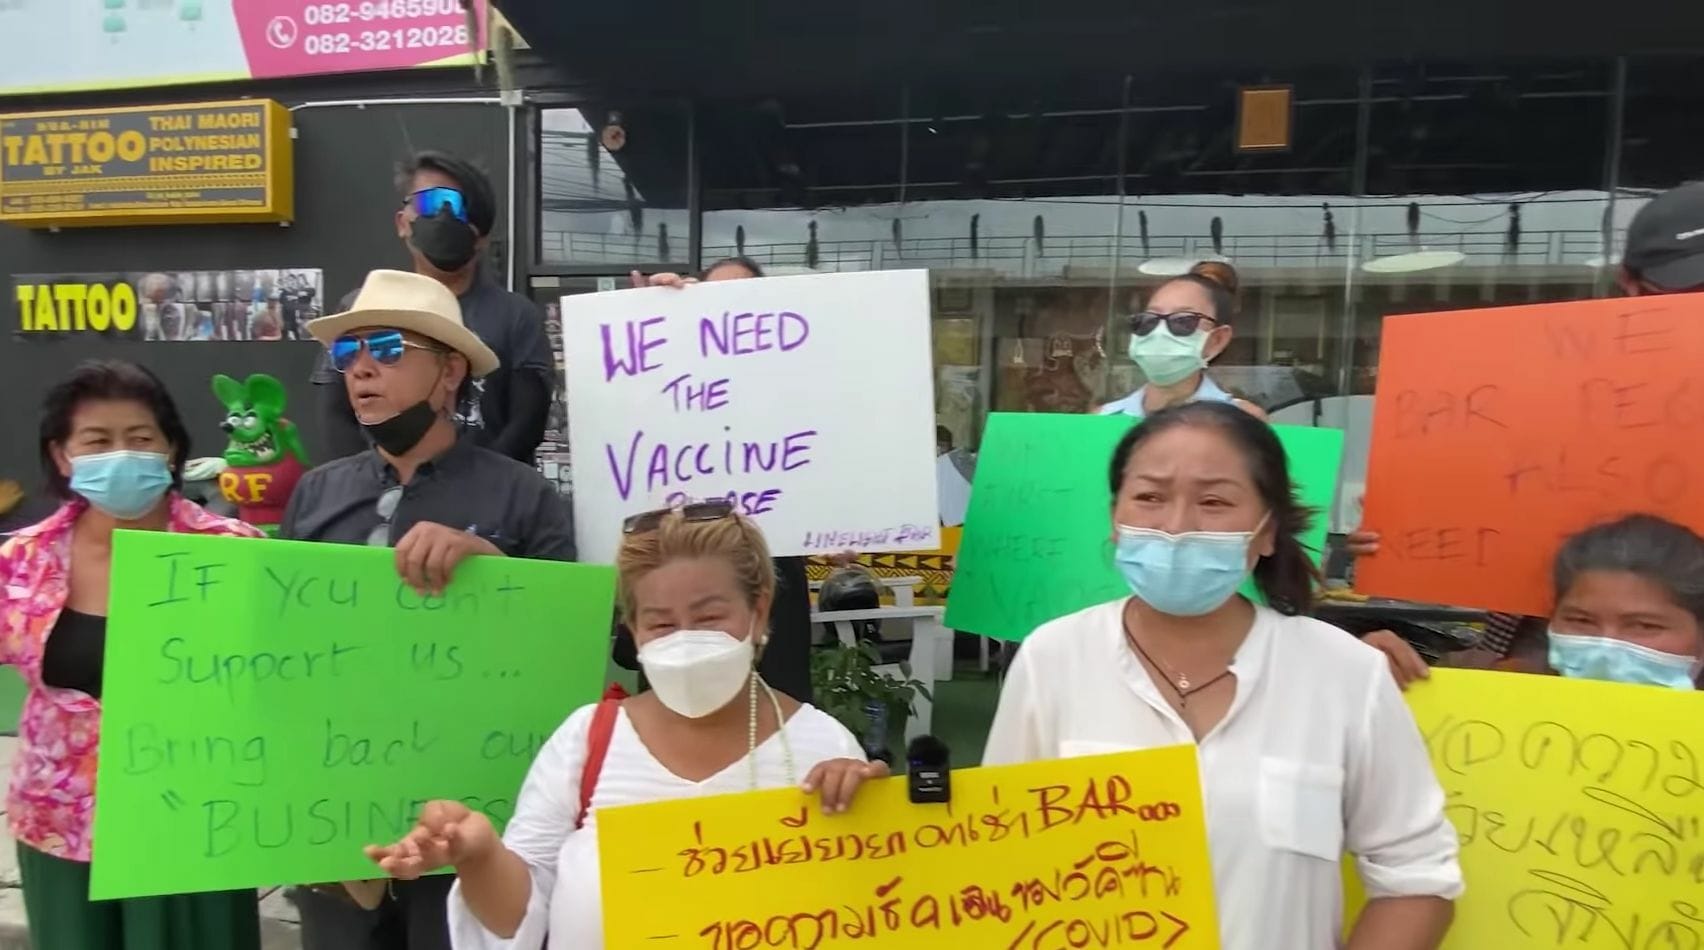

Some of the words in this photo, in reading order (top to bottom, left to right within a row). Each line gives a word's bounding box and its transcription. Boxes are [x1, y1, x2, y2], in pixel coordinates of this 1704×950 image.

[304, 24, 469, 54] 082-3212028
[149, 115, 191, 131] THAI
[198, 112, 260, 129] MAORI
[4, 130, 146, 166] TATTOO
[149, 133, 260, 151] POLYNESIAN
[149, 153, 262, 171] INSPIRED
[17, 282, 137, 332] TATTOO
[600, 316, 667, 383] WE
[700, 311, 809, 357] NEED
[661, 373, 730, 413] THE
[1395, 384, 1510, 440] BAR
[148, 552, 226, 607] IF
[123, 721, 268, 787] Bring
